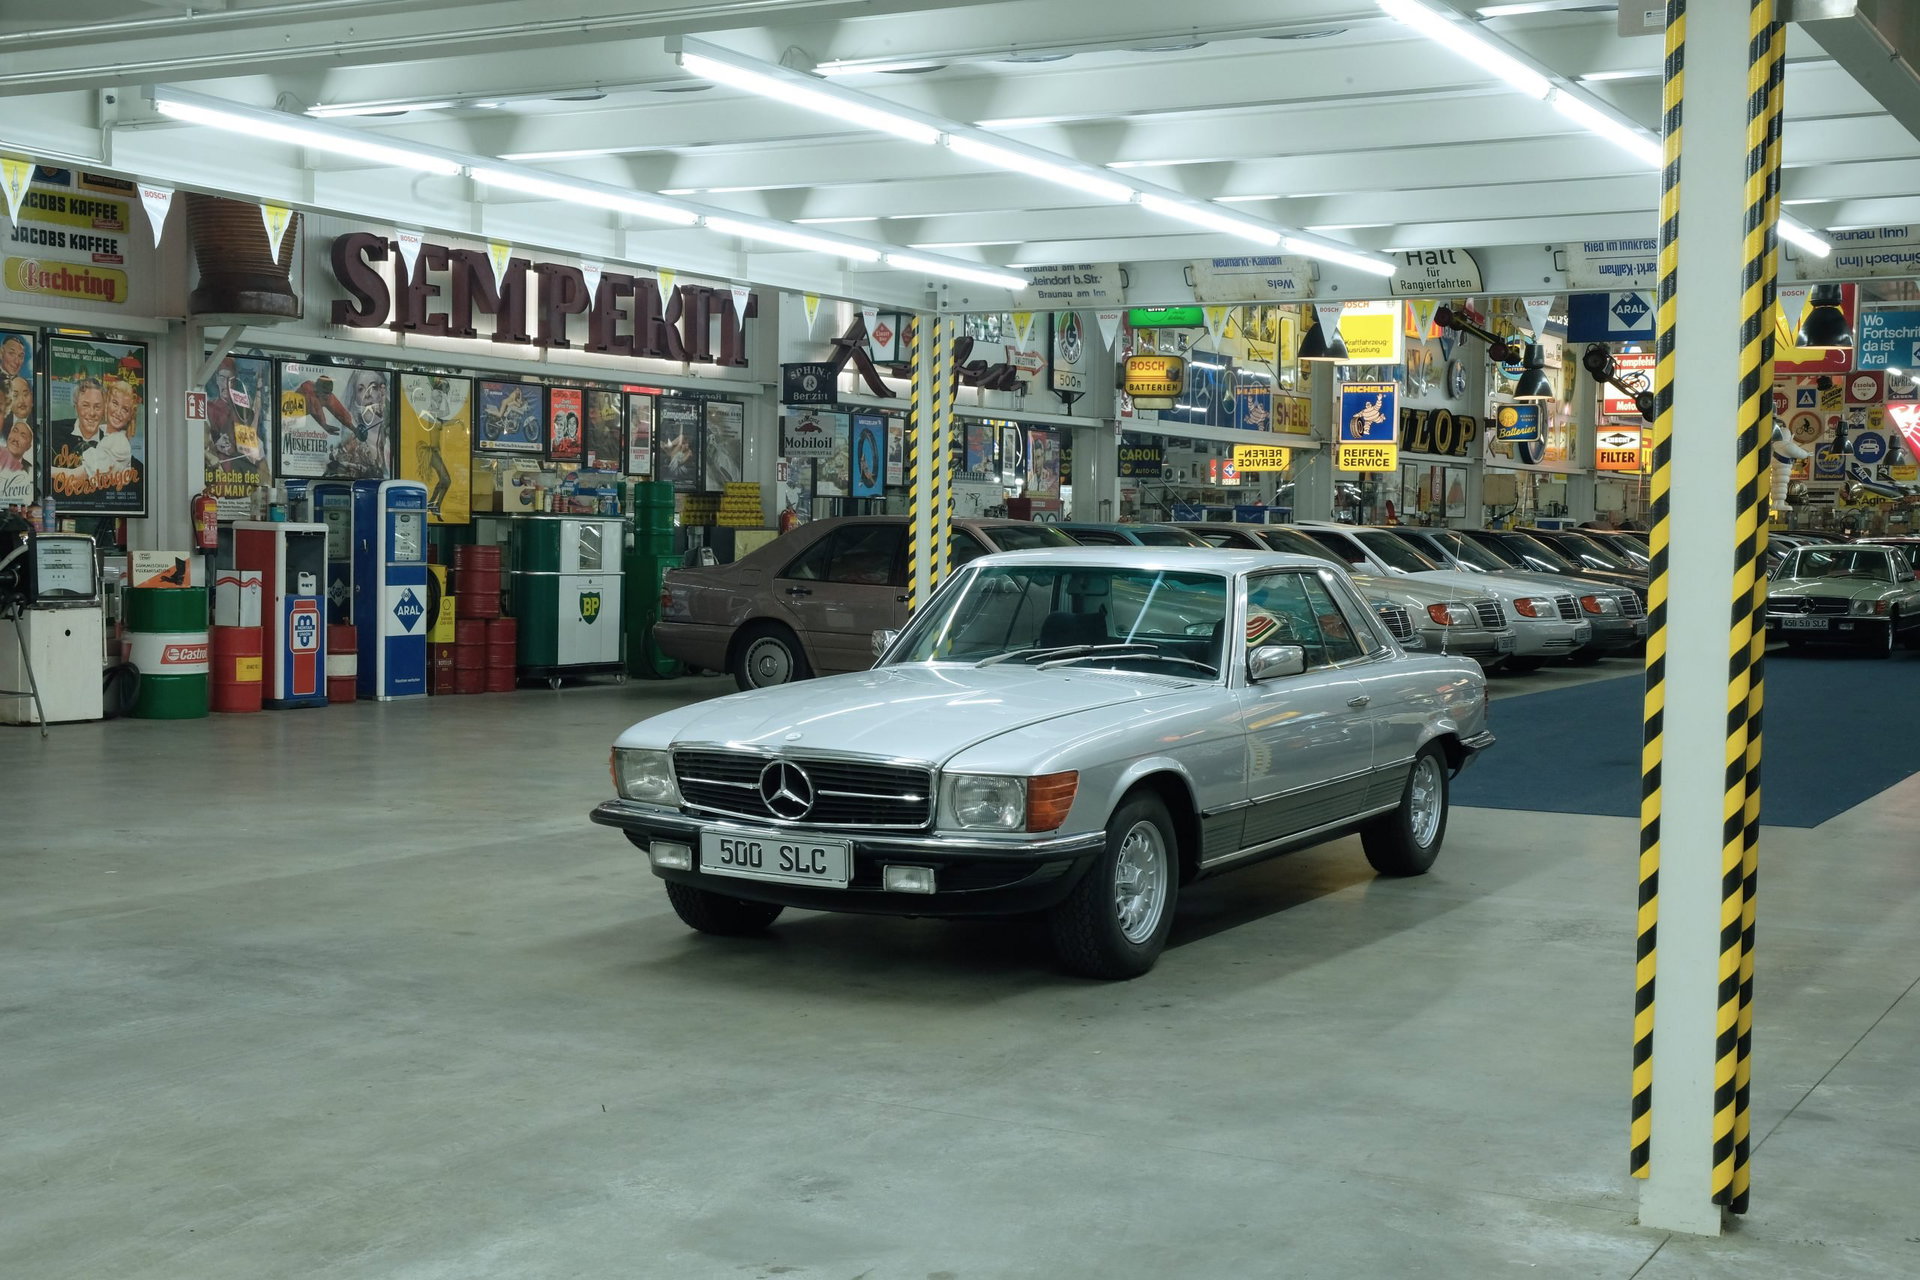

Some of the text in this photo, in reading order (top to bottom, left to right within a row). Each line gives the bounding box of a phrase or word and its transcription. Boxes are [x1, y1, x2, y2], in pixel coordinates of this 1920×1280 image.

[144, 190, 167, 200] BOSCH
[21, 191, 118, 221] ACOBS KAFFEE
[11, 226, 118, 255] JACOBS KAFFEE
[400, 234, 418, 243] BOSCH
[1830, 229, 1875, 241] raunau
[1620, 239, 1656, 251] Innkreis
[1406, 248, 1457, 266] Halt
[1835, 251, 1920, 268] Simbach (Inn)
[1426, 267, 1441, 277] für
[1401, 278, 1472, 292] Rangierfahrten
[331, 231, 758, 368] SEMPERIT
[1038, 290, 1073, 299] Braunau
[1615, 304, 1645, 314] ARAL
[1863, 315, 1884, 326] Wo
[1863, 326, 1920, 339] Fortschrit
[1862, 339, 1895, 351] da ist
[1862, 353, 1888, 365] Aral
[1130, 360, 1165, 371] BOSCH
[790, 365, 831, 380] SPHIN
[1129, 383, 1178, 392] BATTERIEN
[1344, 385, 1393, 393] MICHELIN
[1276, 403, 1309, 427] SHELL
[1500, 426, 1536, 438] Batterien
[282, 435, 328, 455] MUSKETIER
[784, 437, 832, 449] Mobiloil
[1119, 448, 1161, 461] CAROIL
[1344, 449, 1389, 457] REIFEN-
[1601, 451, 1635, 463] FILTER
[1343, 458, 1390, 467] SERVICE
[54, 466, 139, 497] Obersteiger
[205, 468, 260, 484] ie Rache des
[1, 472, 30, 497] Krone
[224, 484, 245, 497] MAN
[397, 604, 421, 616] ARAL
[582, 597, 600, 617] BP
[1784, 618, 1797, 627] 450
[1812, 618, 1827, 627] SLC
[180, 648, 208, 661] Castrol
[720, 839, 827, 874] 500 SLC
